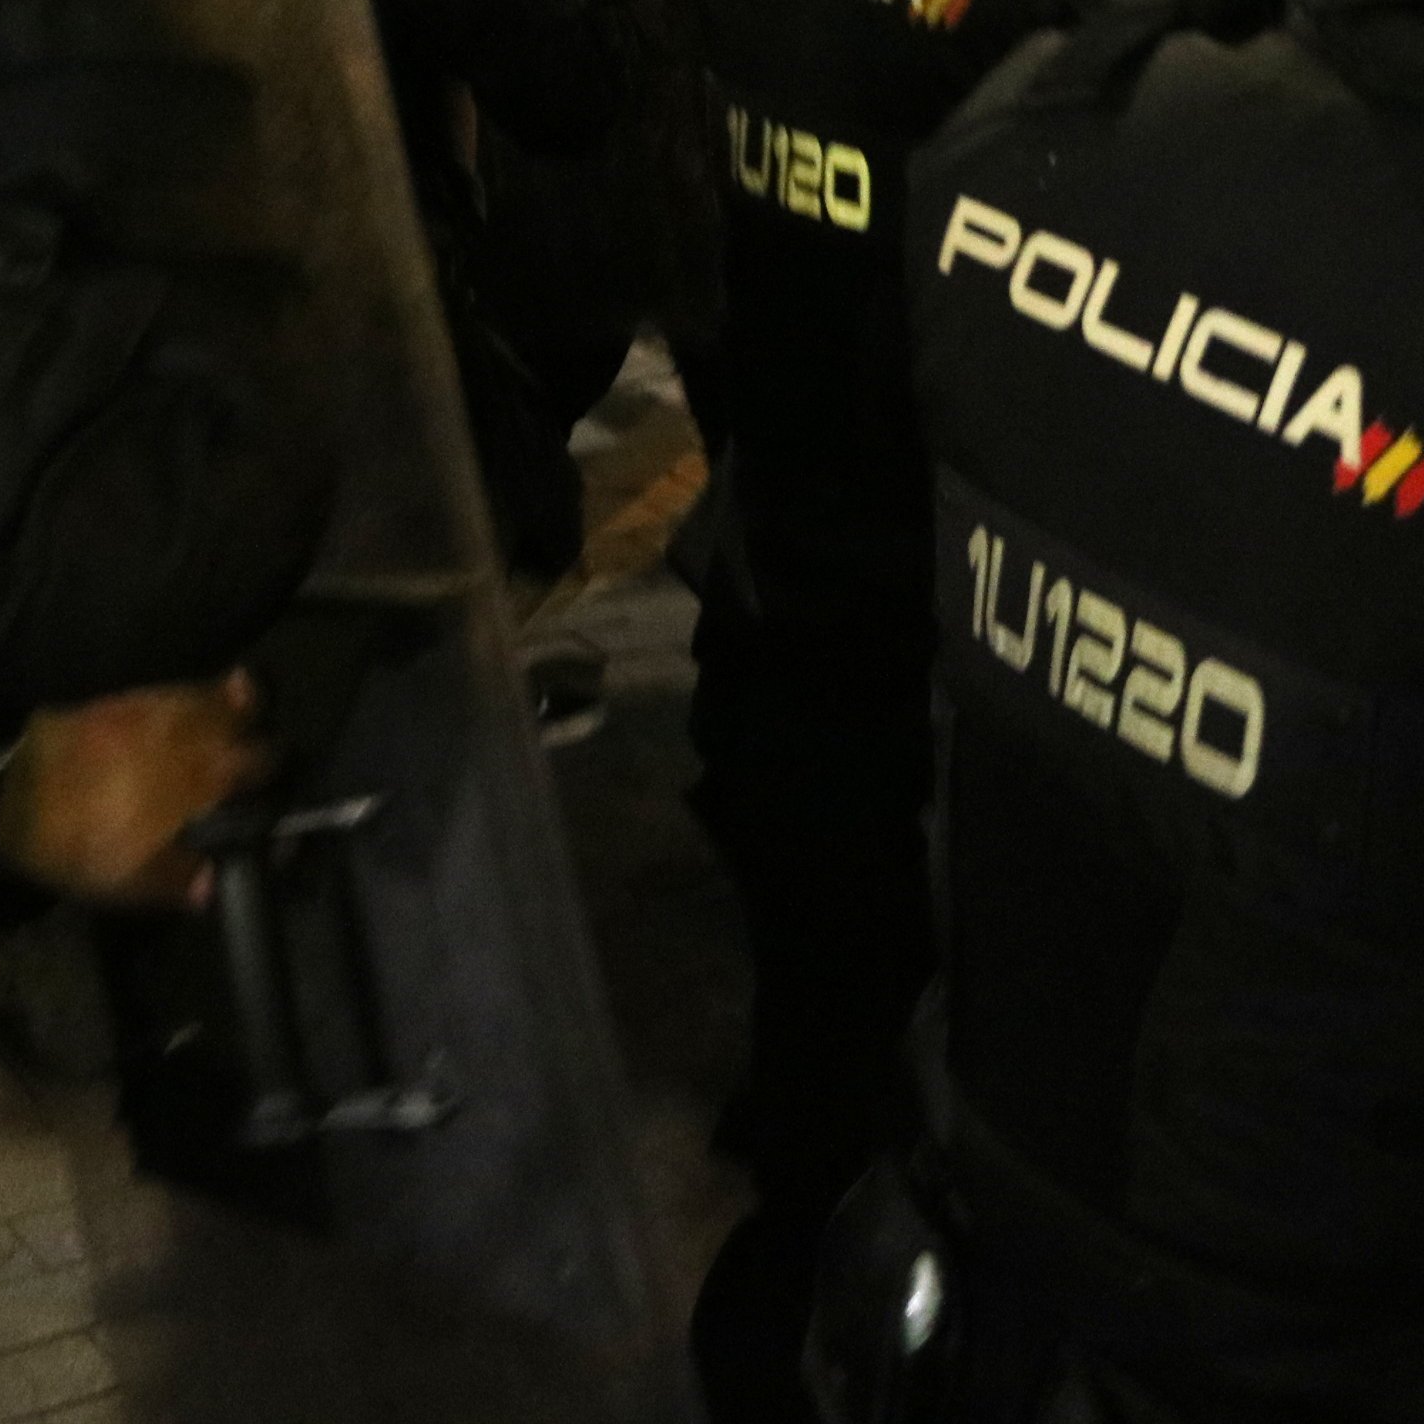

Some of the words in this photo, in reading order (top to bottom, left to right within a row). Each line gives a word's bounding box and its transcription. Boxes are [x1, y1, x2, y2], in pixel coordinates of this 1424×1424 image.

[727, 103, 871, 233] 1U120
[938, 194, 1364, 470] POLICIA
[968, 525, 1265, 799] 1U1220
